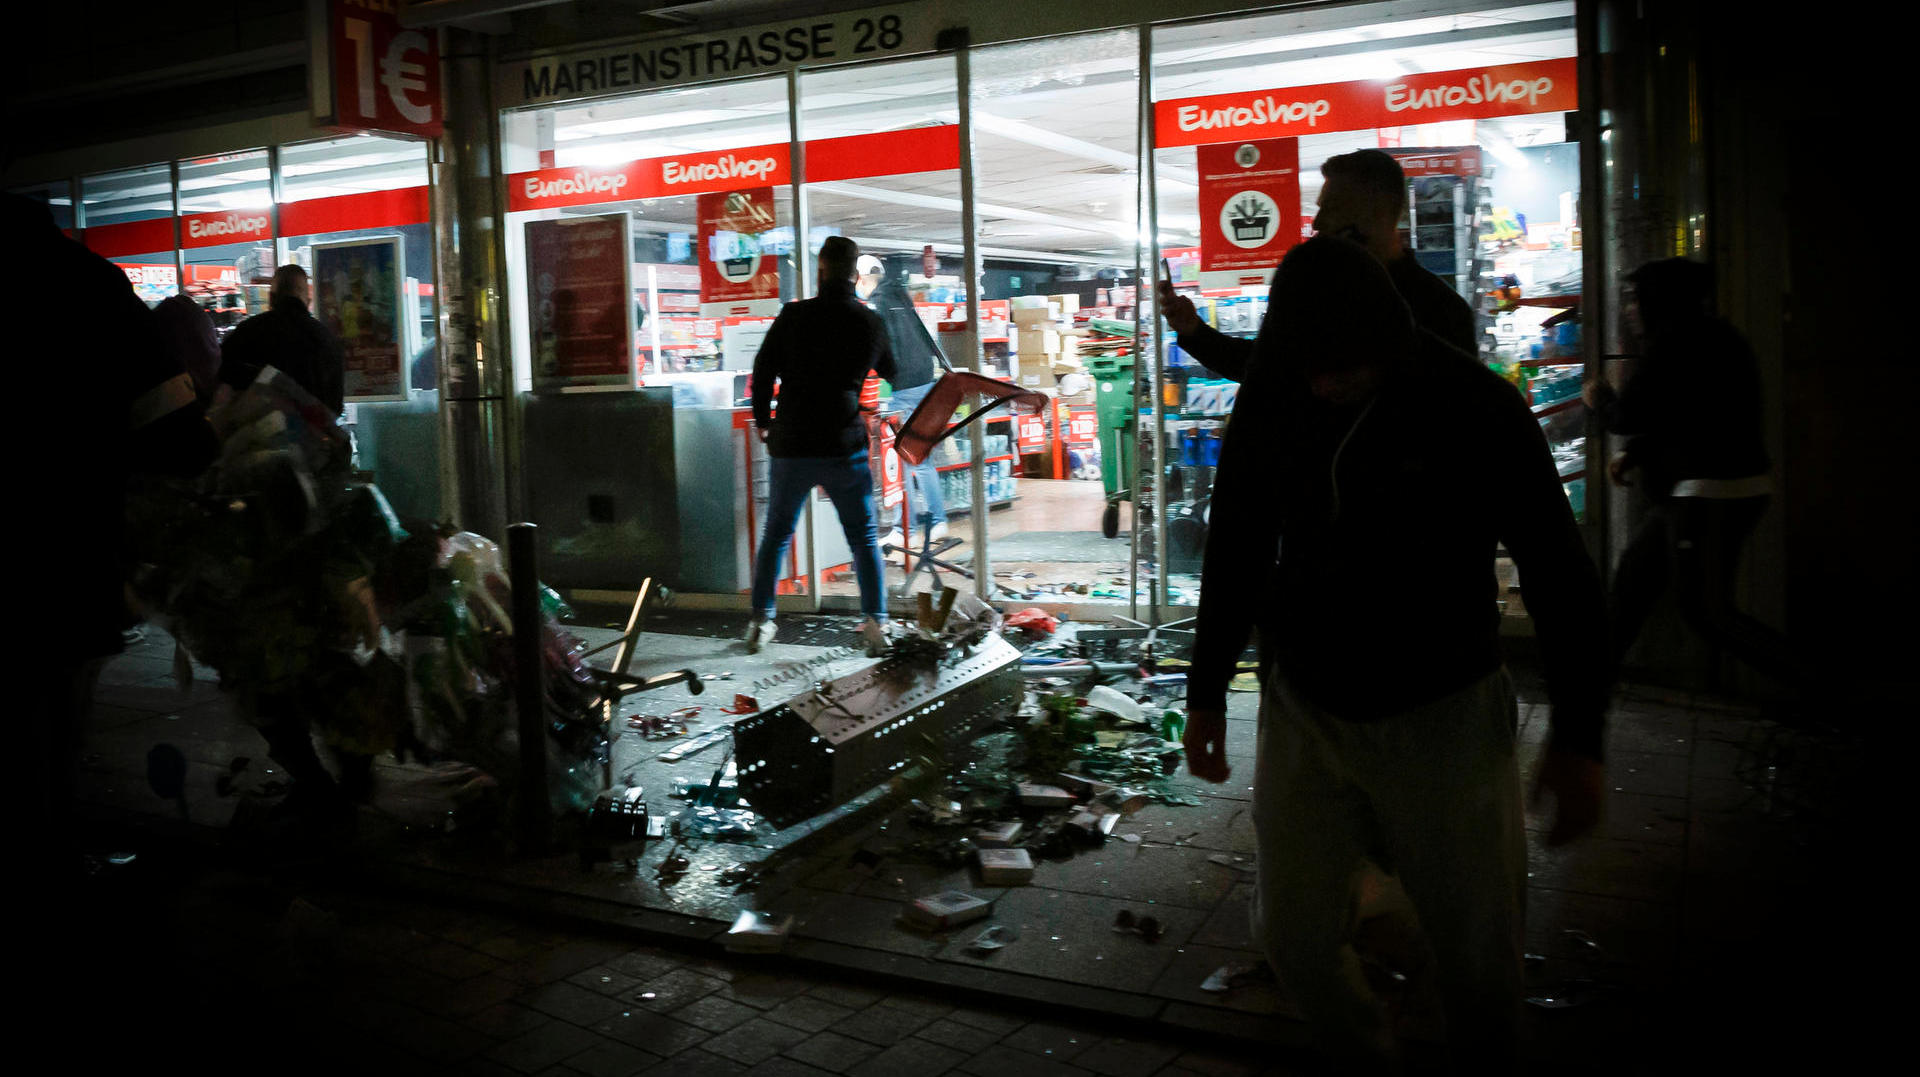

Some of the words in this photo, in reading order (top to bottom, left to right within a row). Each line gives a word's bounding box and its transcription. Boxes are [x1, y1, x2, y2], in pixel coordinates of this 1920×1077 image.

[344, 17, 433, 124] 1€
[525, 22, 835, 99] MARIENSTRASSE
[852, 14, 903, 54] 28
[1386, 74, 1554, 112] EuroShop
[1178, 97, 1330, 132] EuroShop
[525, 170, 627, 200] EuroShop
[663, 154, 777, 186] EuroShop
[189, 215, 267, 239] EuroShop
